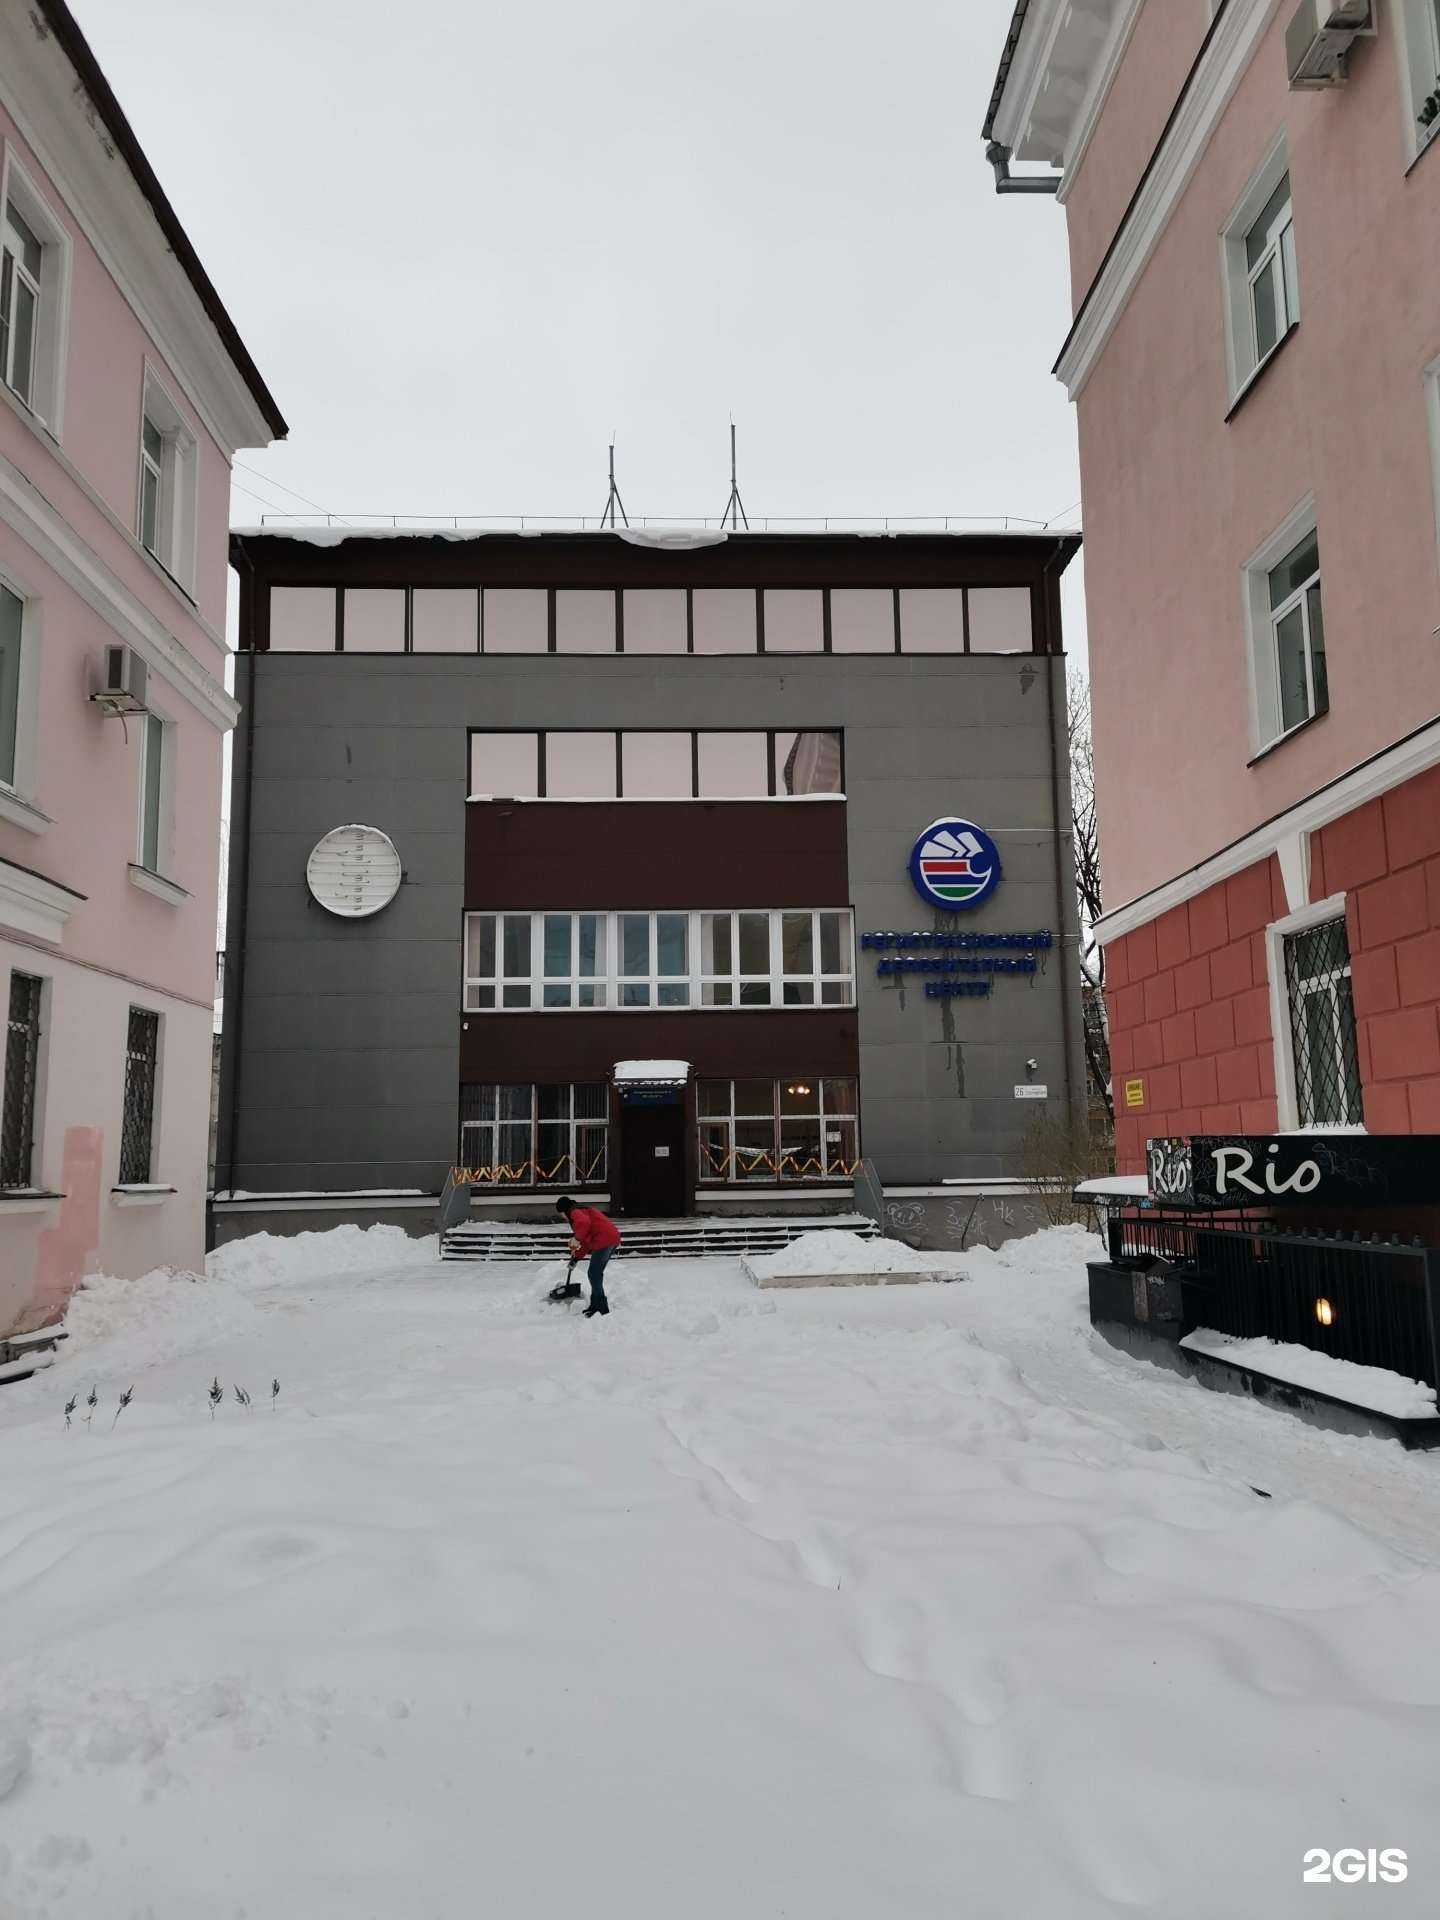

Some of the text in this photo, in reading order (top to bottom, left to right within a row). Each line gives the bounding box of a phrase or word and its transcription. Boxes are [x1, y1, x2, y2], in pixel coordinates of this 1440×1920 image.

[1015, 1087, 1024, 1097] 26
[1151, 1148, 1188, 1194] Rio
[1211, 1143, 1321, 1195] Rio
